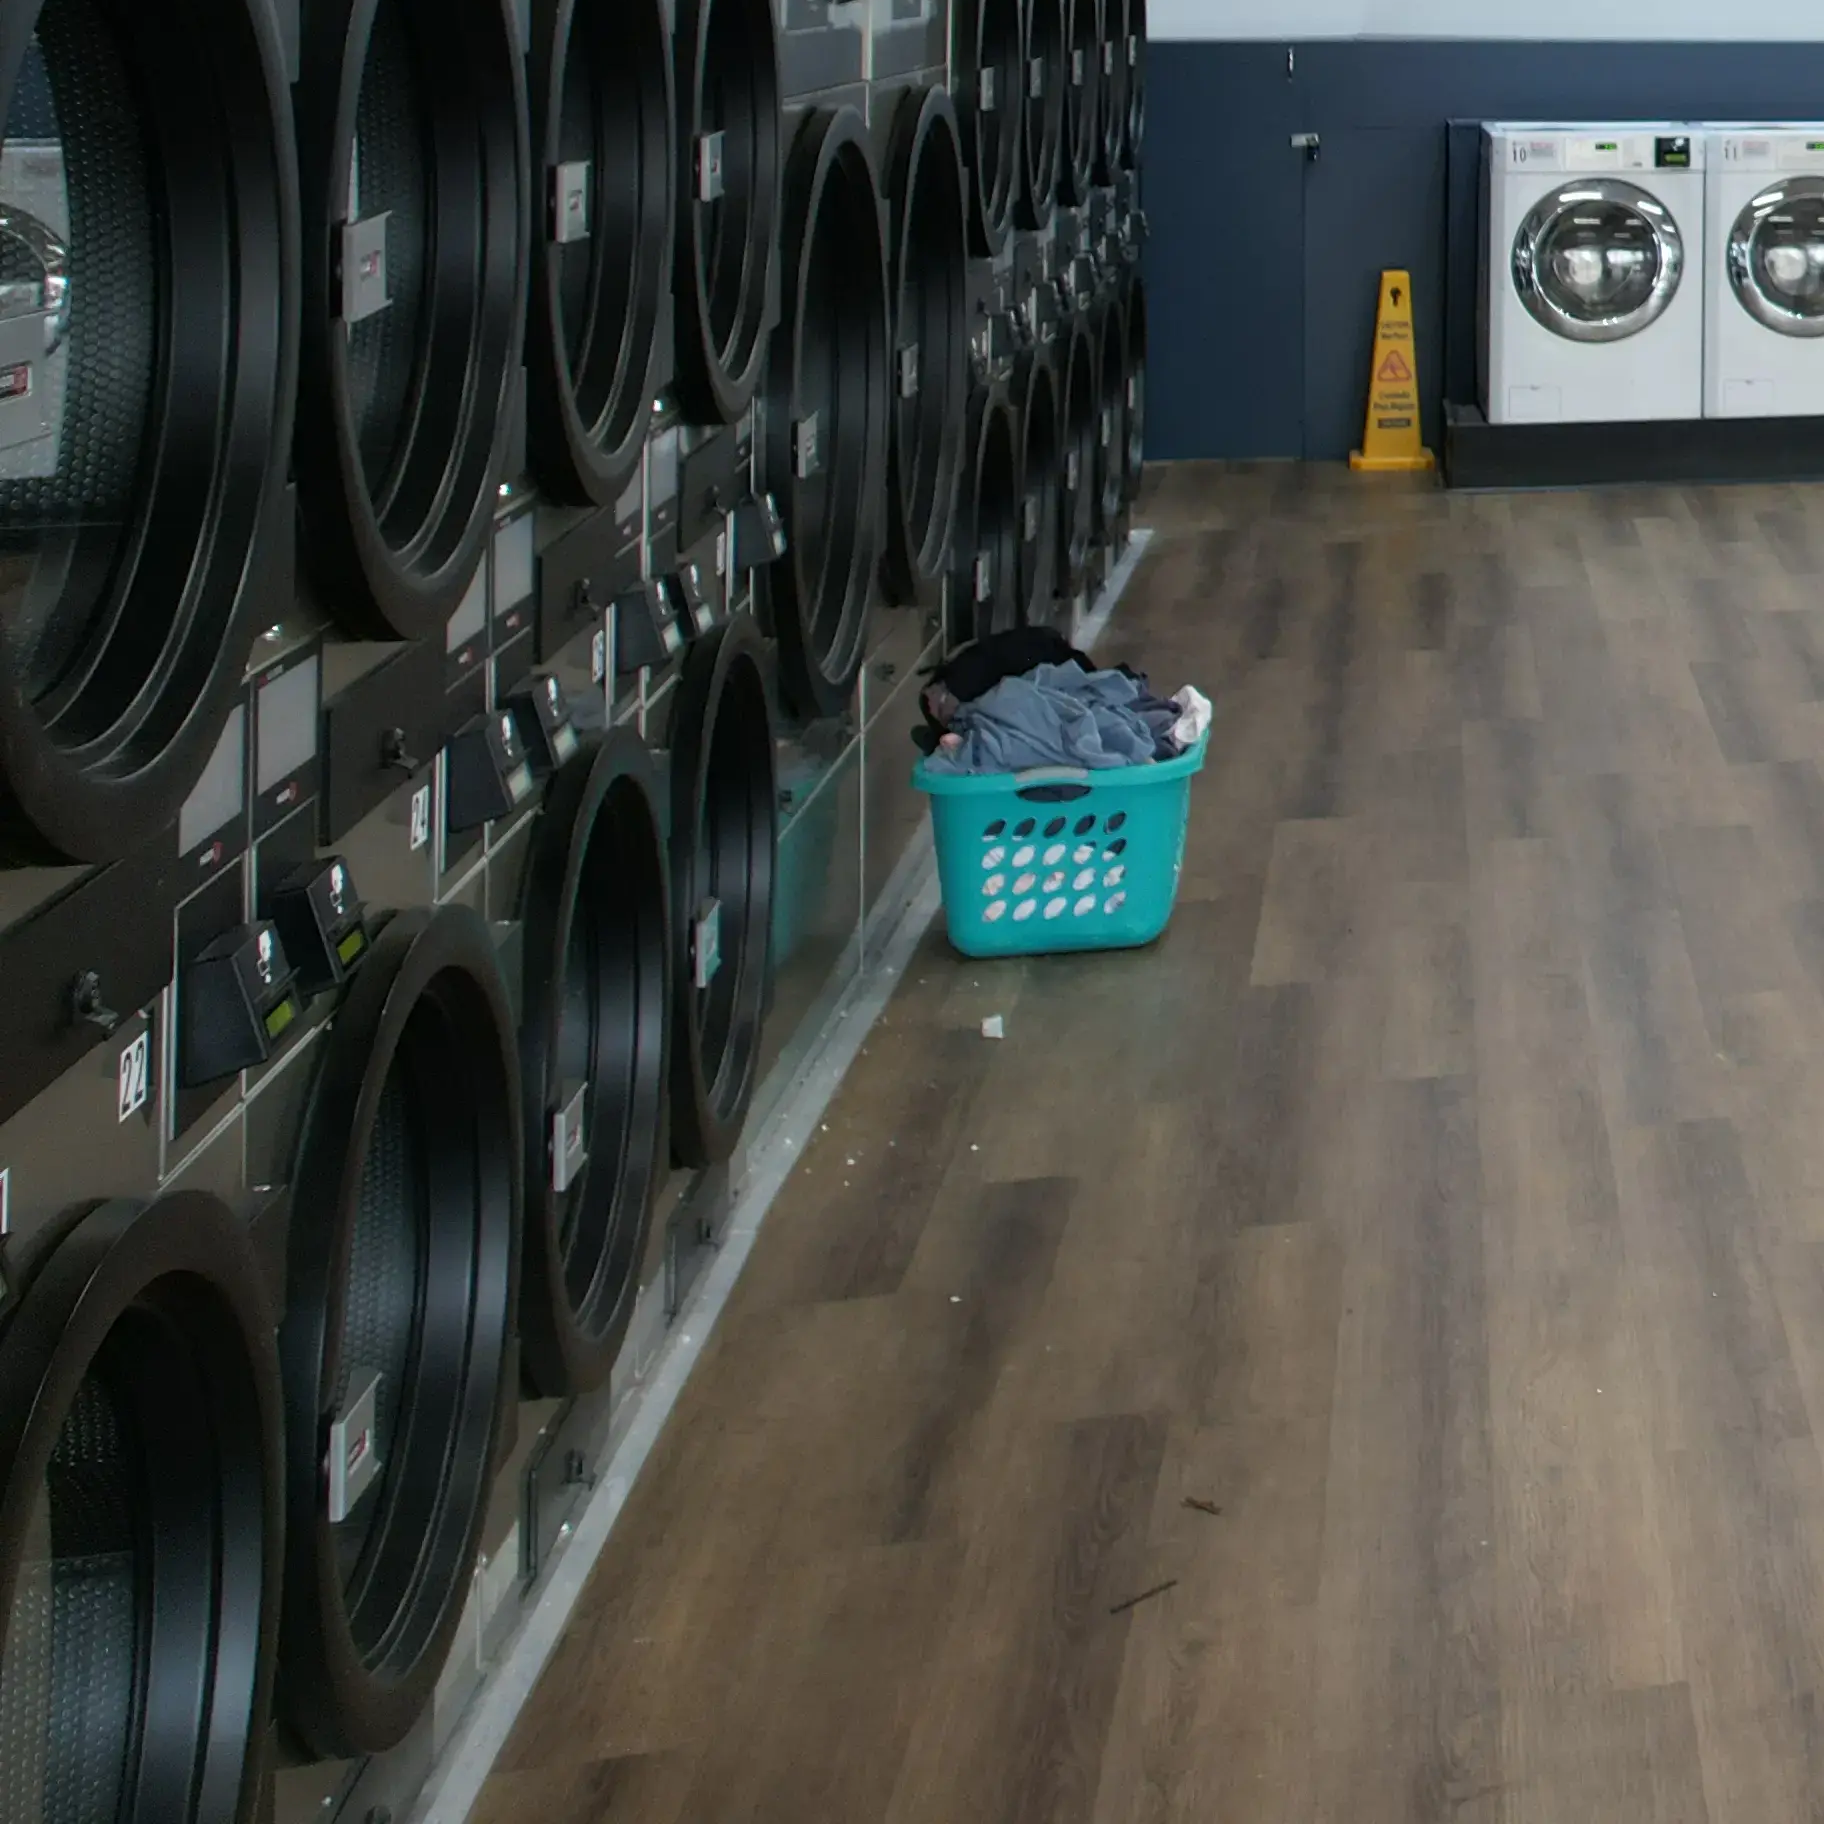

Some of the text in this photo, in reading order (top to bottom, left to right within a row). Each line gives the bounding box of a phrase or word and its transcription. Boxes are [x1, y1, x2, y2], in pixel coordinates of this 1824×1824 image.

[1512, 147, 1527, 163] 10
[1724, 147, 1738, 161] 11
[121, 1039, 145, 1116] 22
